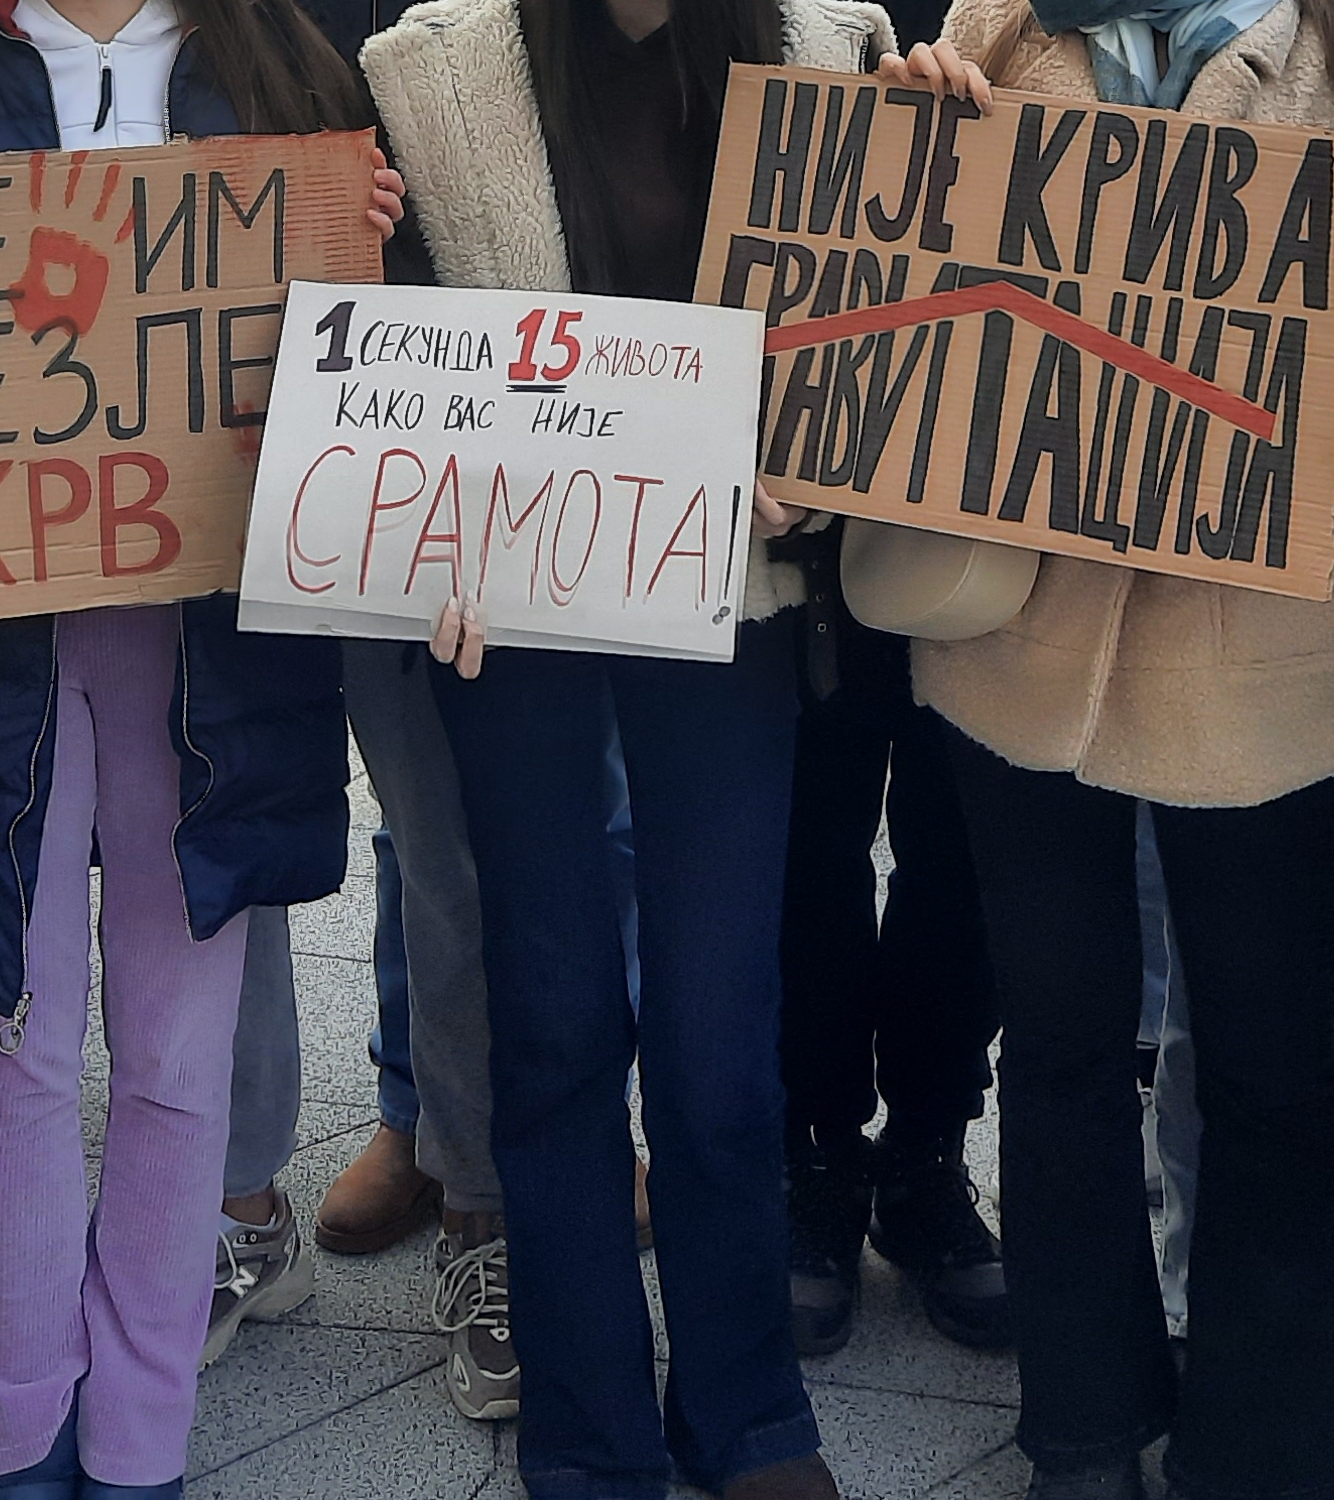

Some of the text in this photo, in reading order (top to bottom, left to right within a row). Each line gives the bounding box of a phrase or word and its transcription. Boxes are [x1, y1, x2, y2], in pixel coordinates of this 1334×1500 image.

[133, 168, 286, 294] ИМ
[747, 78, 1334, 310] НИЈЕ КРИВА
[314, 301, 703, 384] 1 СЕКУНДА 15 ЖИВОТА
[335, 382, 624, 437] КАКО ВАС НИЈЕ
[286, 445, 741, 625] СРАМОТА!
